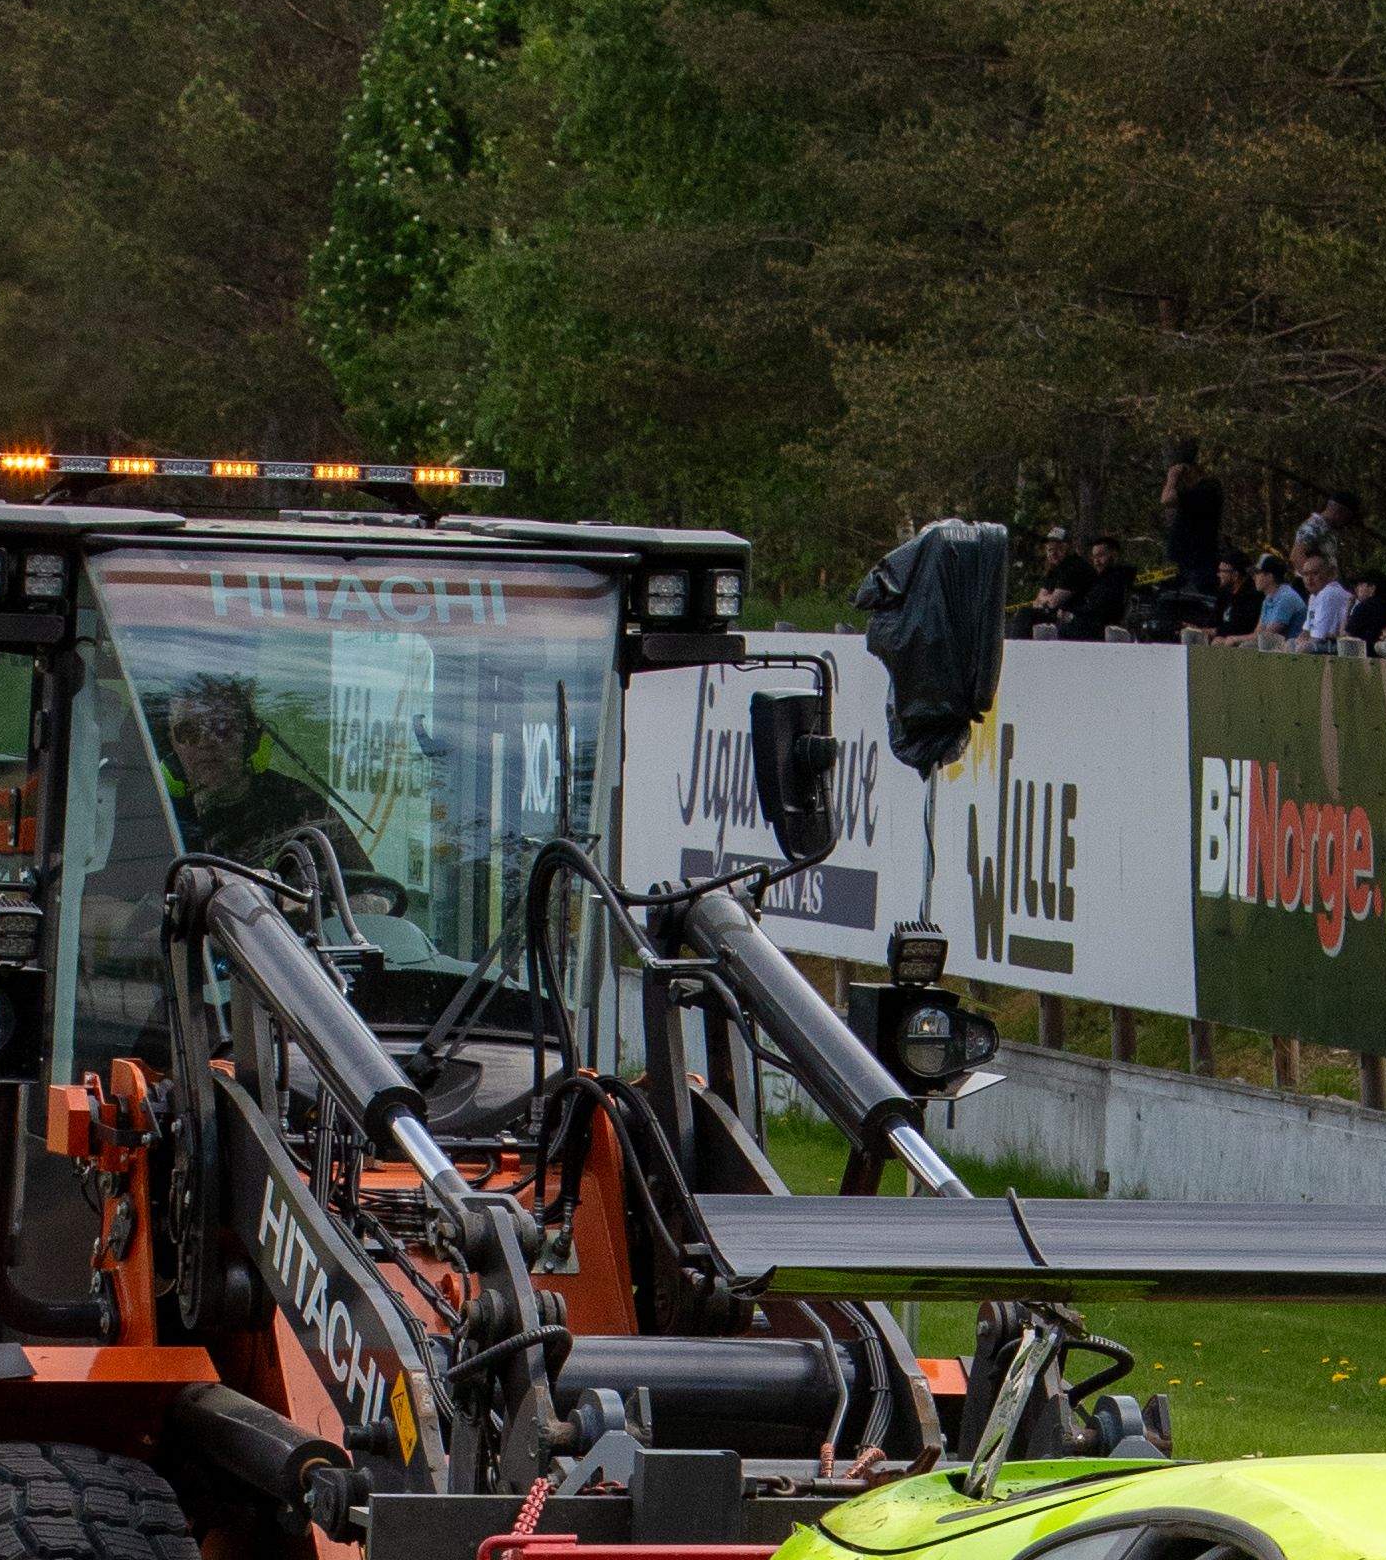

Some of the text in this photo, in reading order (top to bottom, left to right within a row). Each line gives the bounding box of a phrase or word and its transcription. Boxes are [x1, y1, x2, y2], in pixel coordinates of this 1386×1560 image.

[210, 570, 508, 625] HITACHI
[799, 869, 824, 915] AS
[259, 1174, 386, 1425] HITACHI
